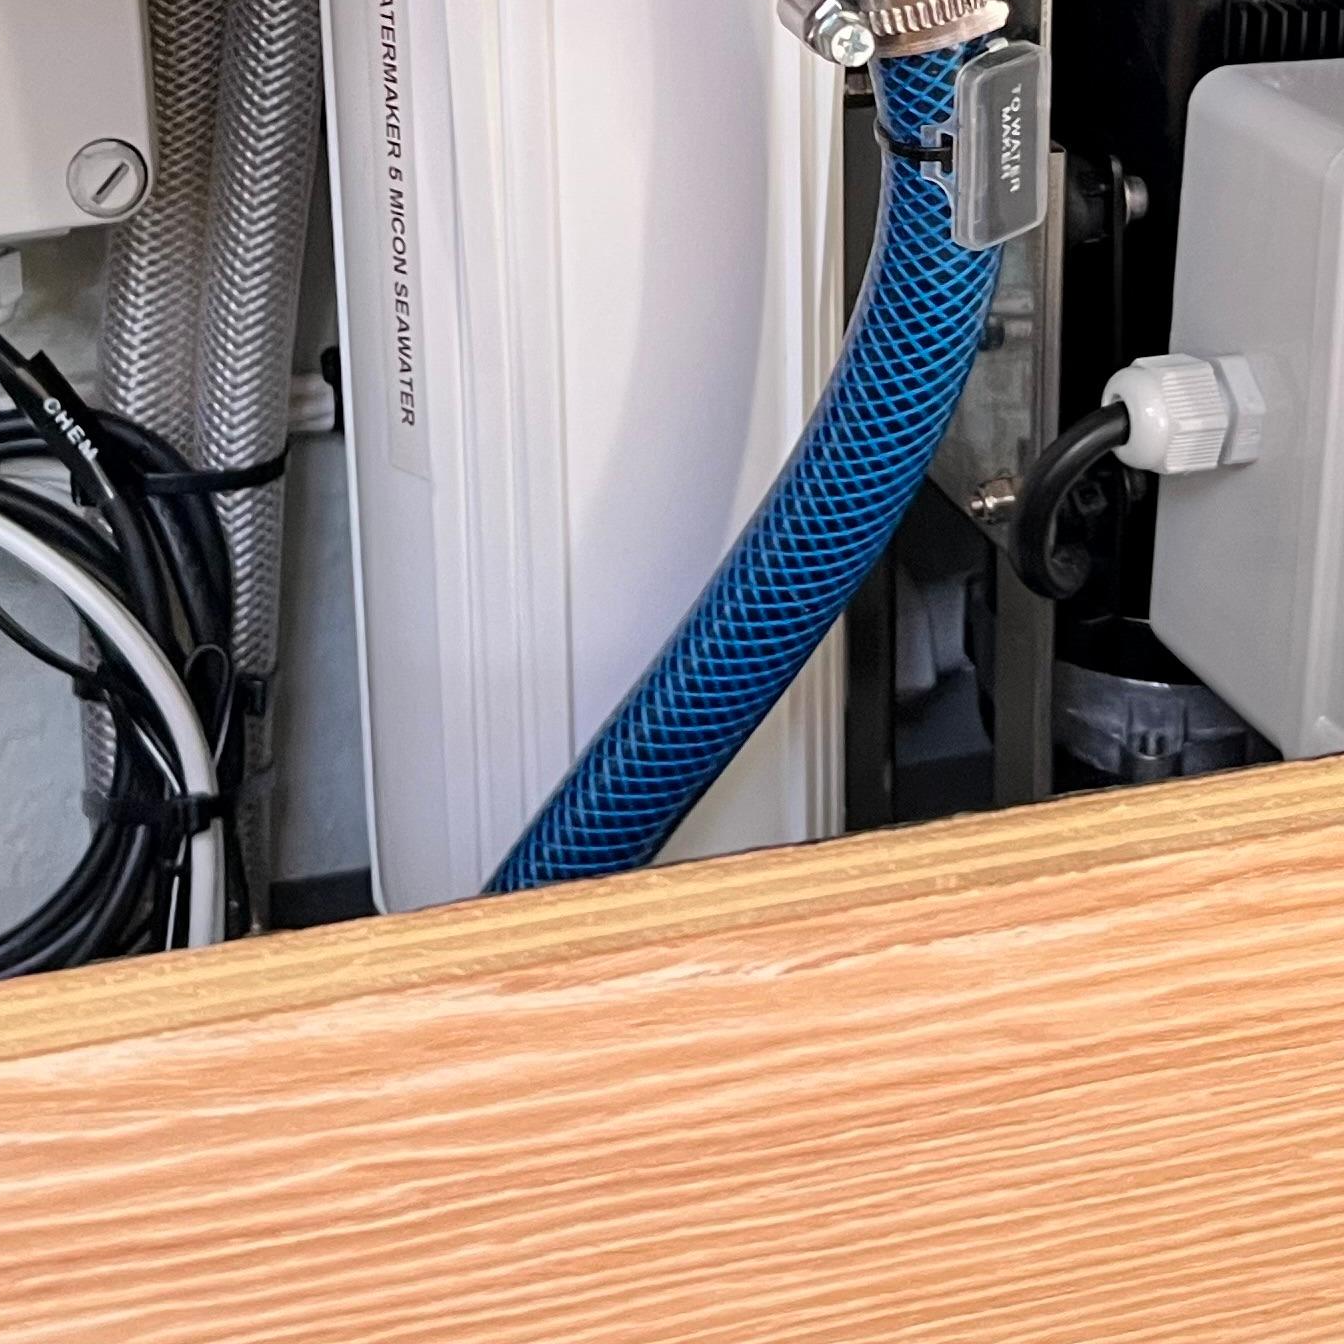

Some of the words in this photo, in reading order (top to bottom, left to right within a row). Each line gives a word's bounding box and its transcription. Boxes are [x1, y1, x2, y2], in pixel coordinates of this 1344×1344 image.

[1011, 82, 1022, 112] TO
[387, 166, 404, 181] 5
[388, 187, 408, 274] MICON
[393, 282, 416, 427] SEAWATER
[43, 396, 99, 461] CHEM
